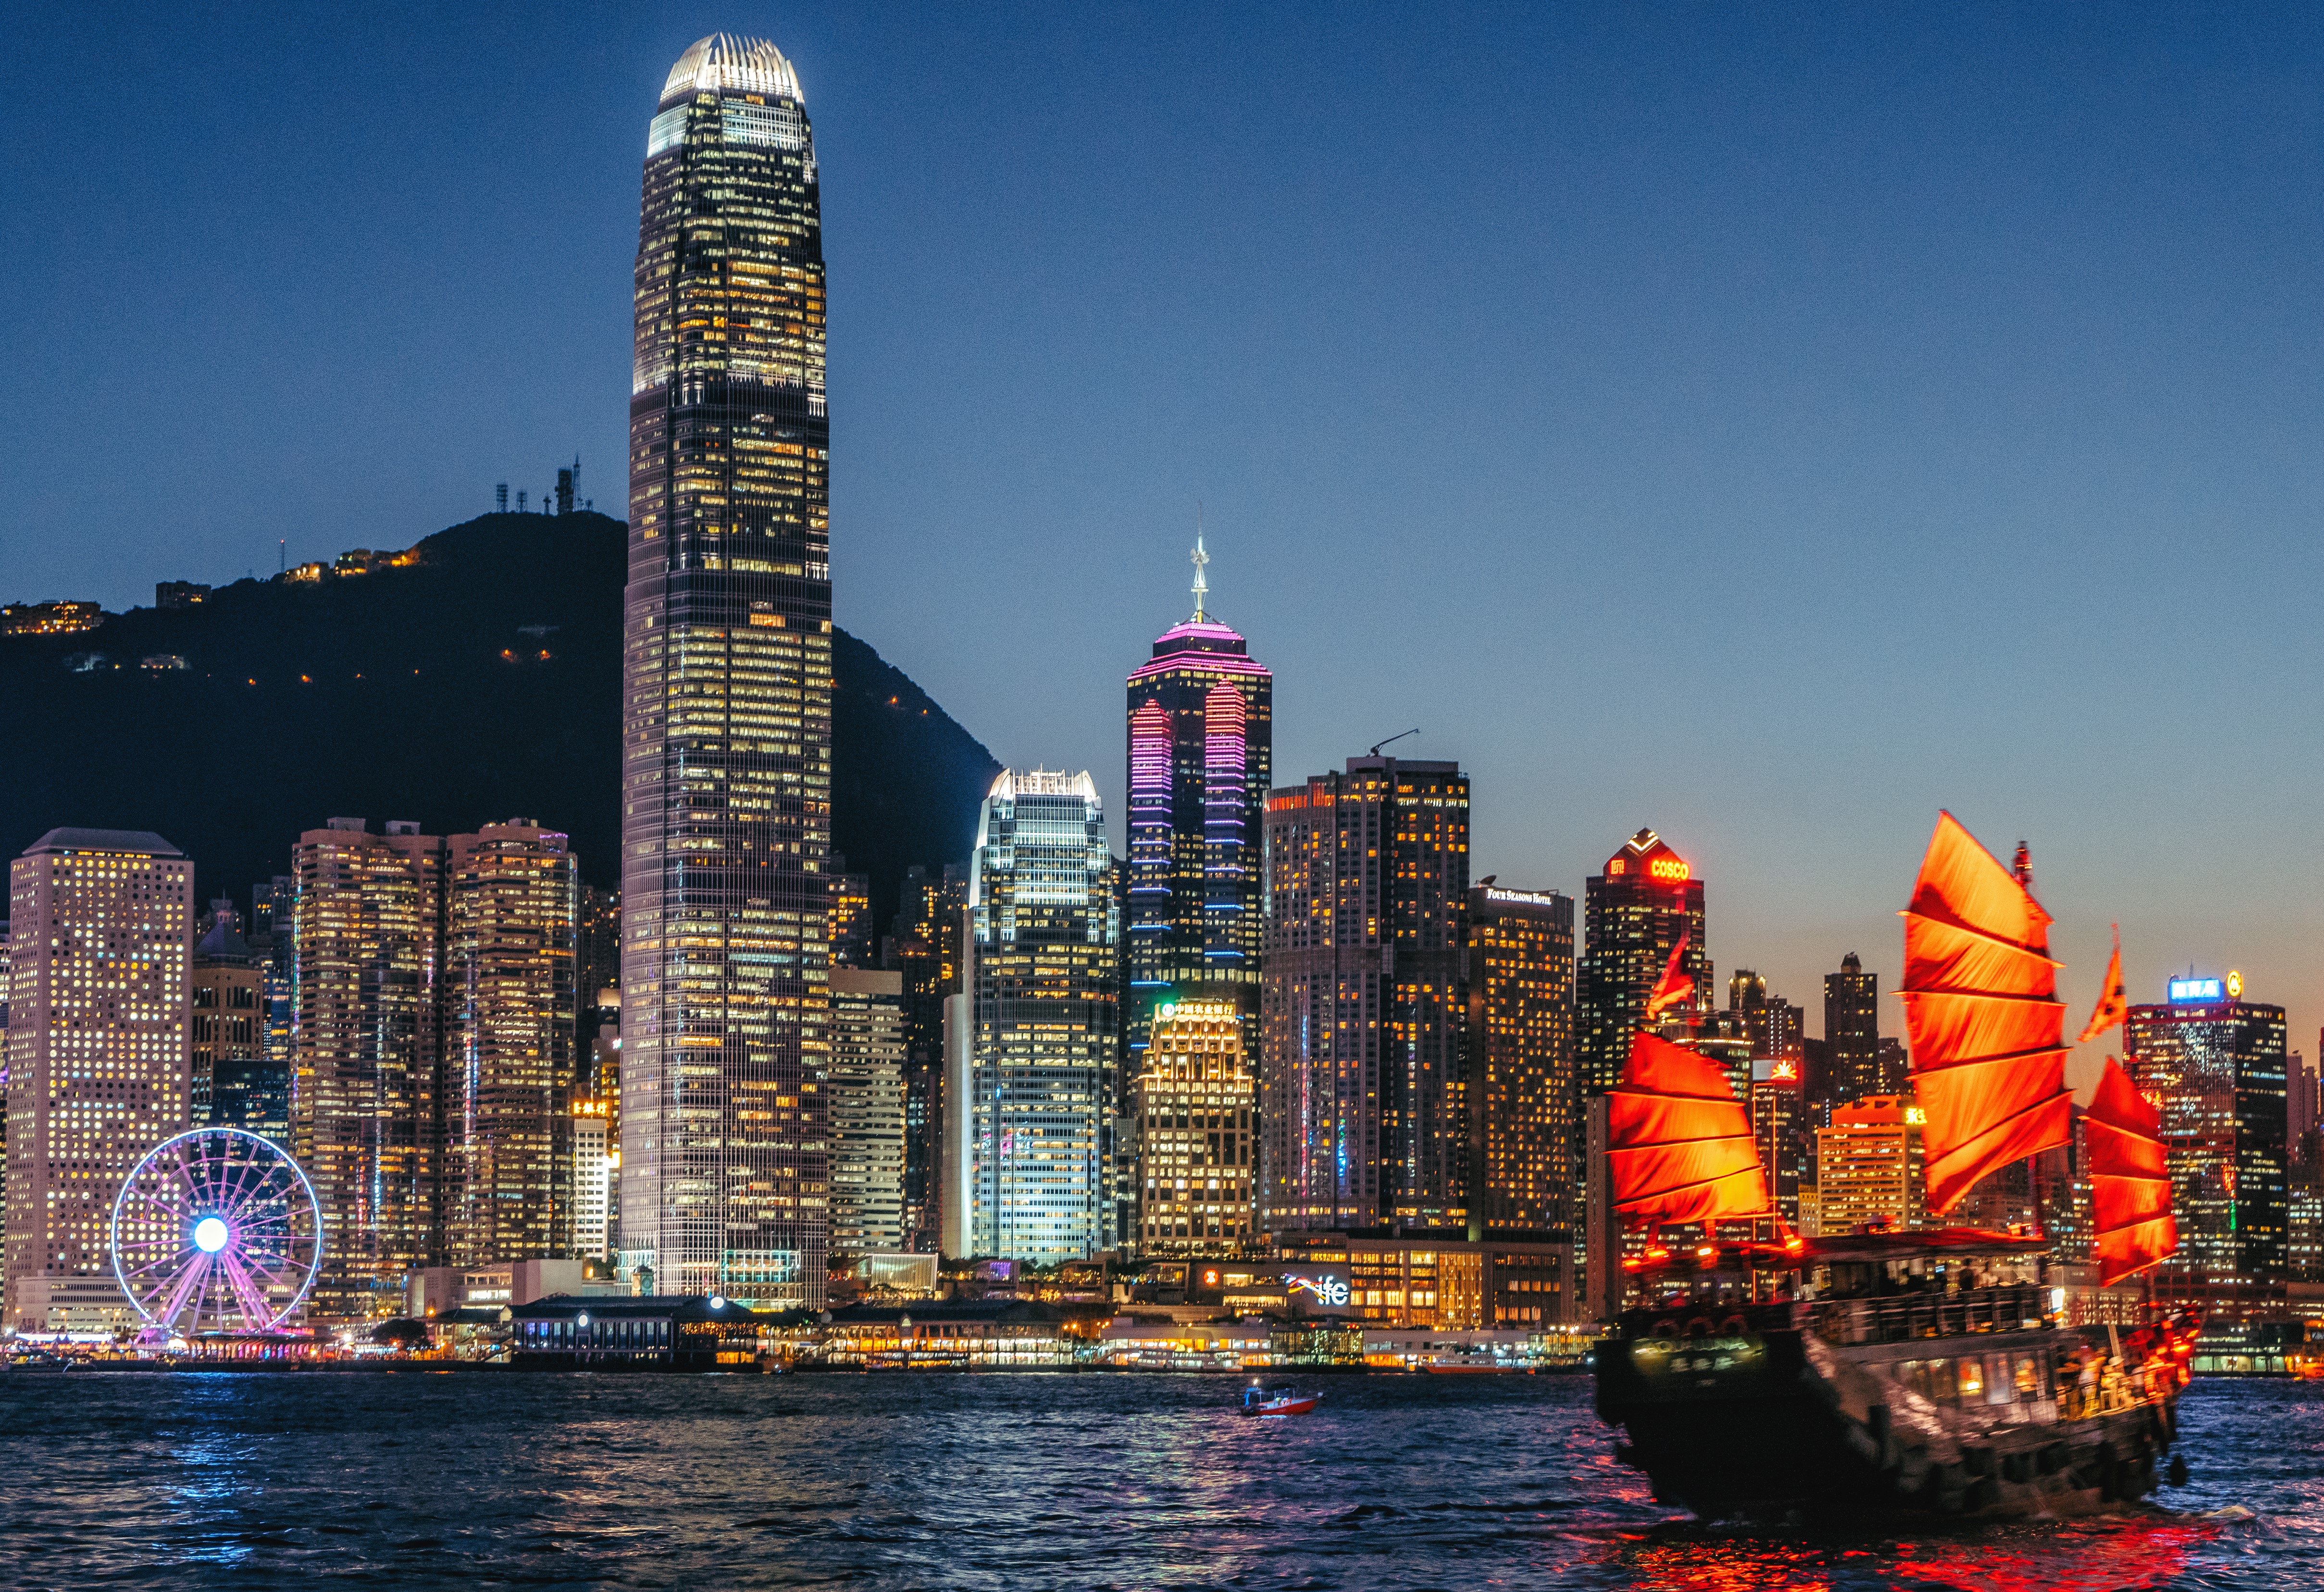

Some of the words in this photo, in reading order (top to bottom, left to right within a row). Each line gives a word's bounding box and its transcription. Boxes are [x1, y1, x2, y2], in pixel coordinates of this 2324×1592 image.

[1652, 860, 1689, 880] COSCO
[1487, 888, 1506, 900] FOUR
[1506, 890, 1532, 903] SEASONS
[1532, 893, 1552, 906] HOTEL
[1318, 1276, 1348, 1306] ifc
